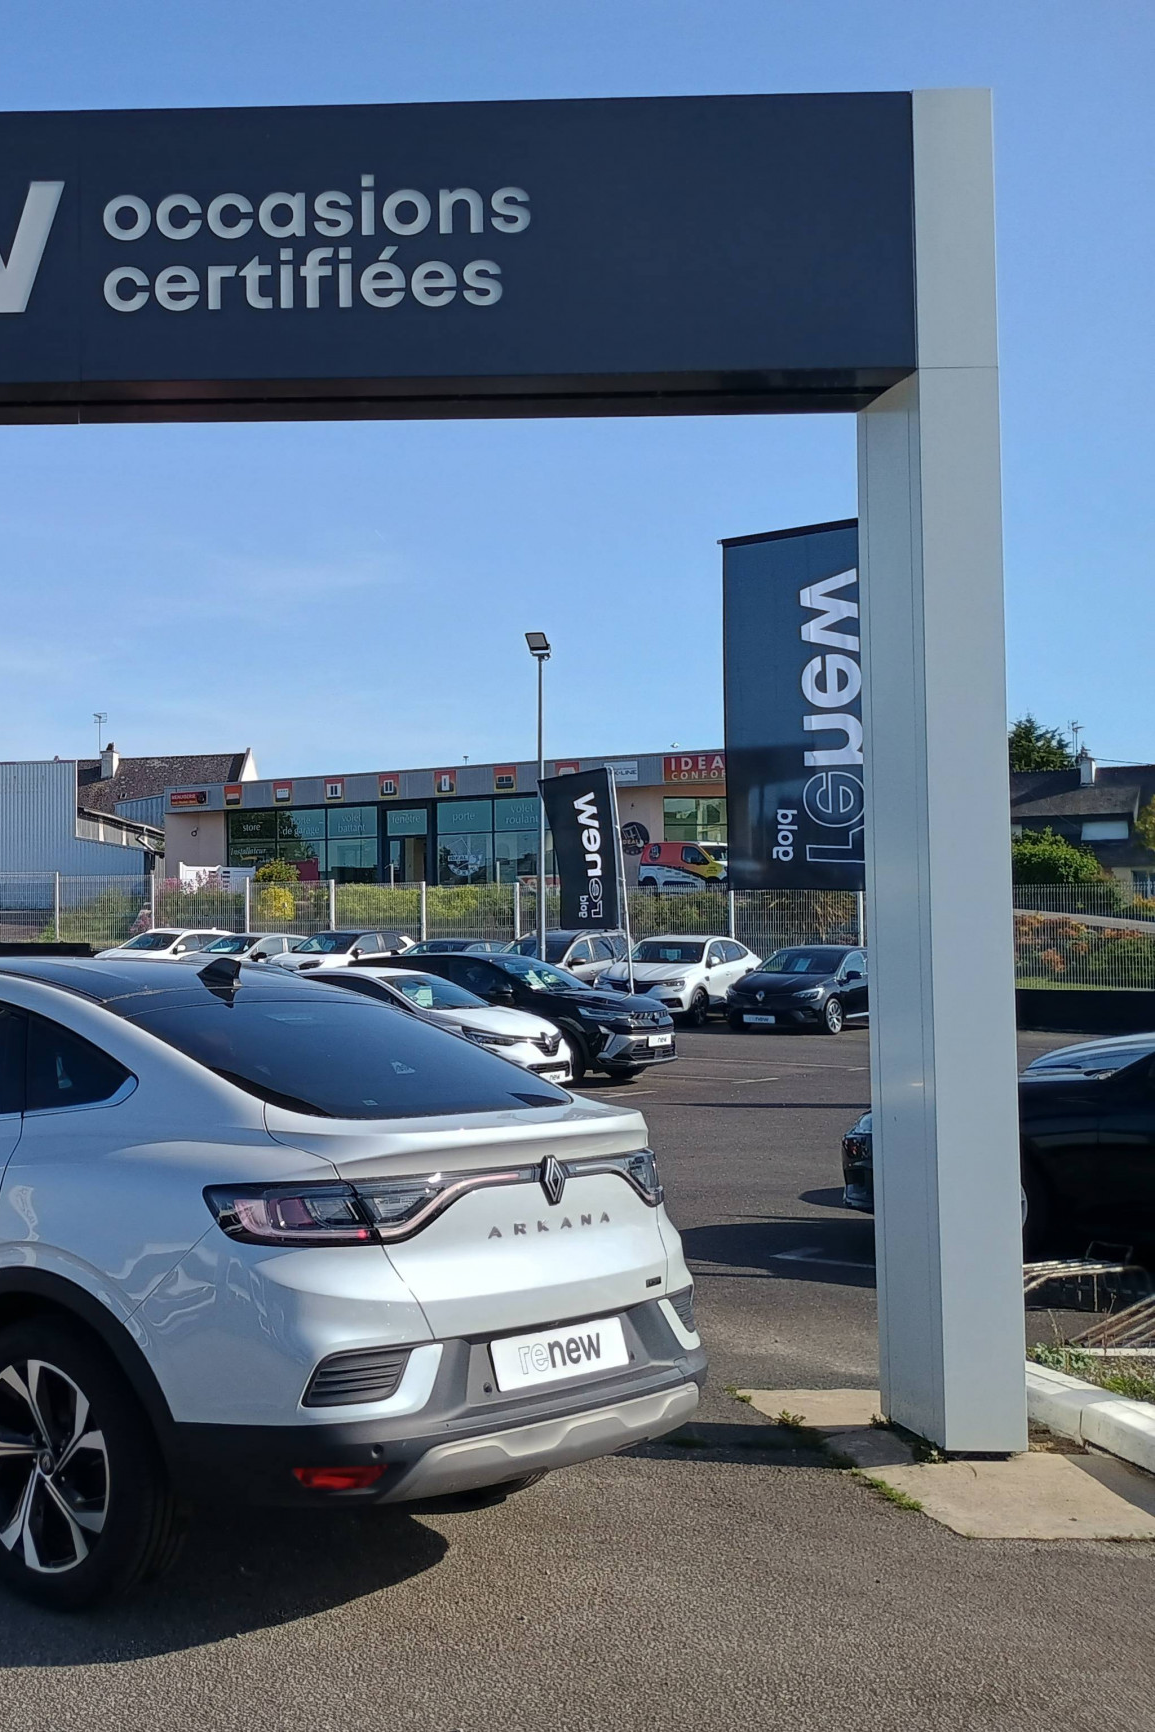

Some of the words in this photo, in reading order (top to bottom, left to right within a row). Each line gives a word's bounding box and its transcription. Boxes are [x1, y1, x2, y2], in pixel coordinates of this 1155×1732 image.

[102, 173, 532, 241] occasions
[103, 246, 503, 312] certifiées
[671, 755, 725, 770] IDEA
[510, 803, 533, 813] volet
[342, 812, 362, 822] volet
[452, 812, 476, 823] porte
[242, 824, 261, 832] store
[283, 826, 293, 835] de
[294, 826, 321, 837] garage
[487, 1211, 610, 1239] ARKANA
[517, 1332, 601, 1375] renew
